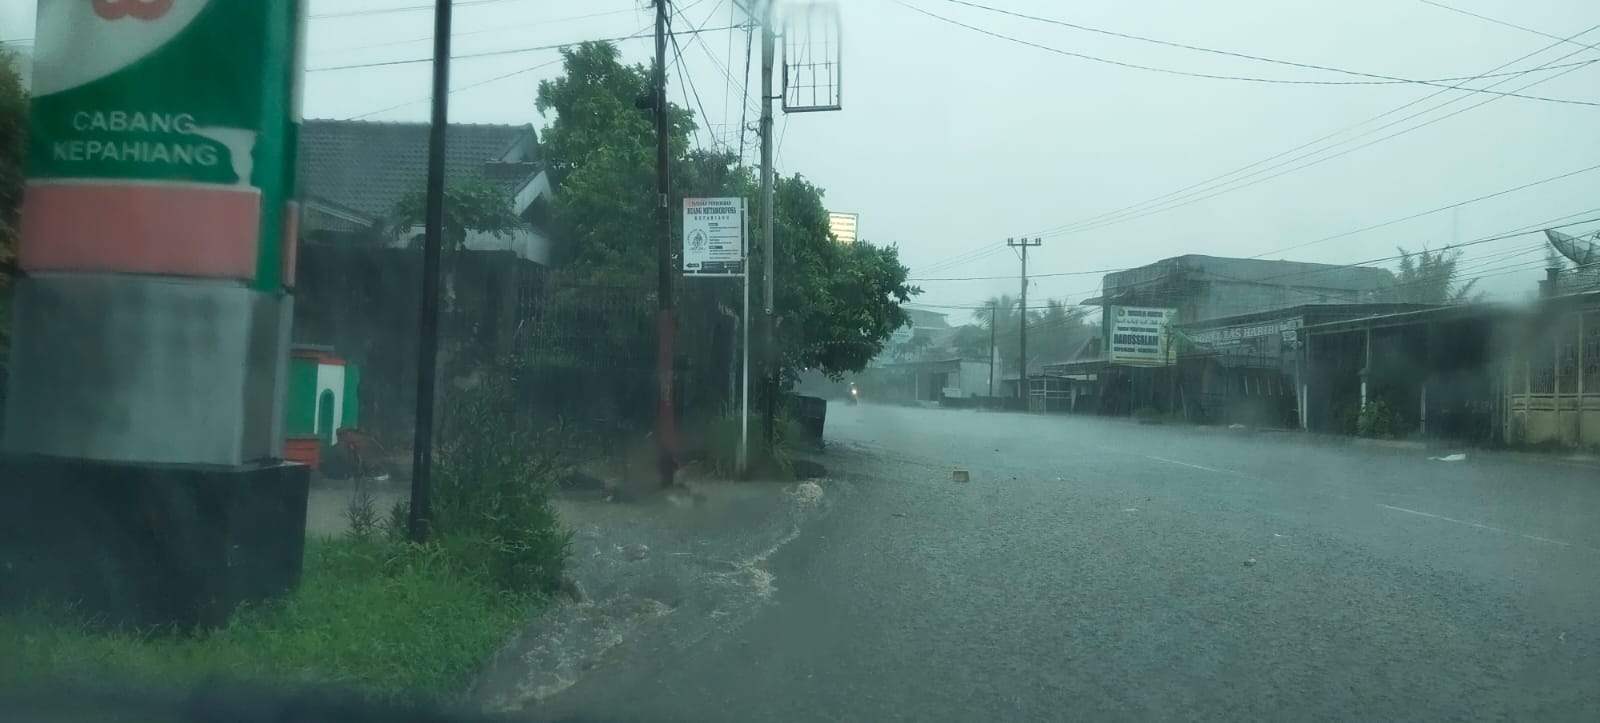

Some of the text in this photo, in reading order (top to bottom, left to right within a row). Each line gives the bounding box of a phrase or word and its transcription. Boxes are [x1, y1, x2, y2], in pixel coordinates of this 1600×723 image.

[72, 111, 196, 134] CABANG
[53, 140, 218, 166] KEPAHIANG
[1113, 333, 1159, 345] DARUSSALAM
